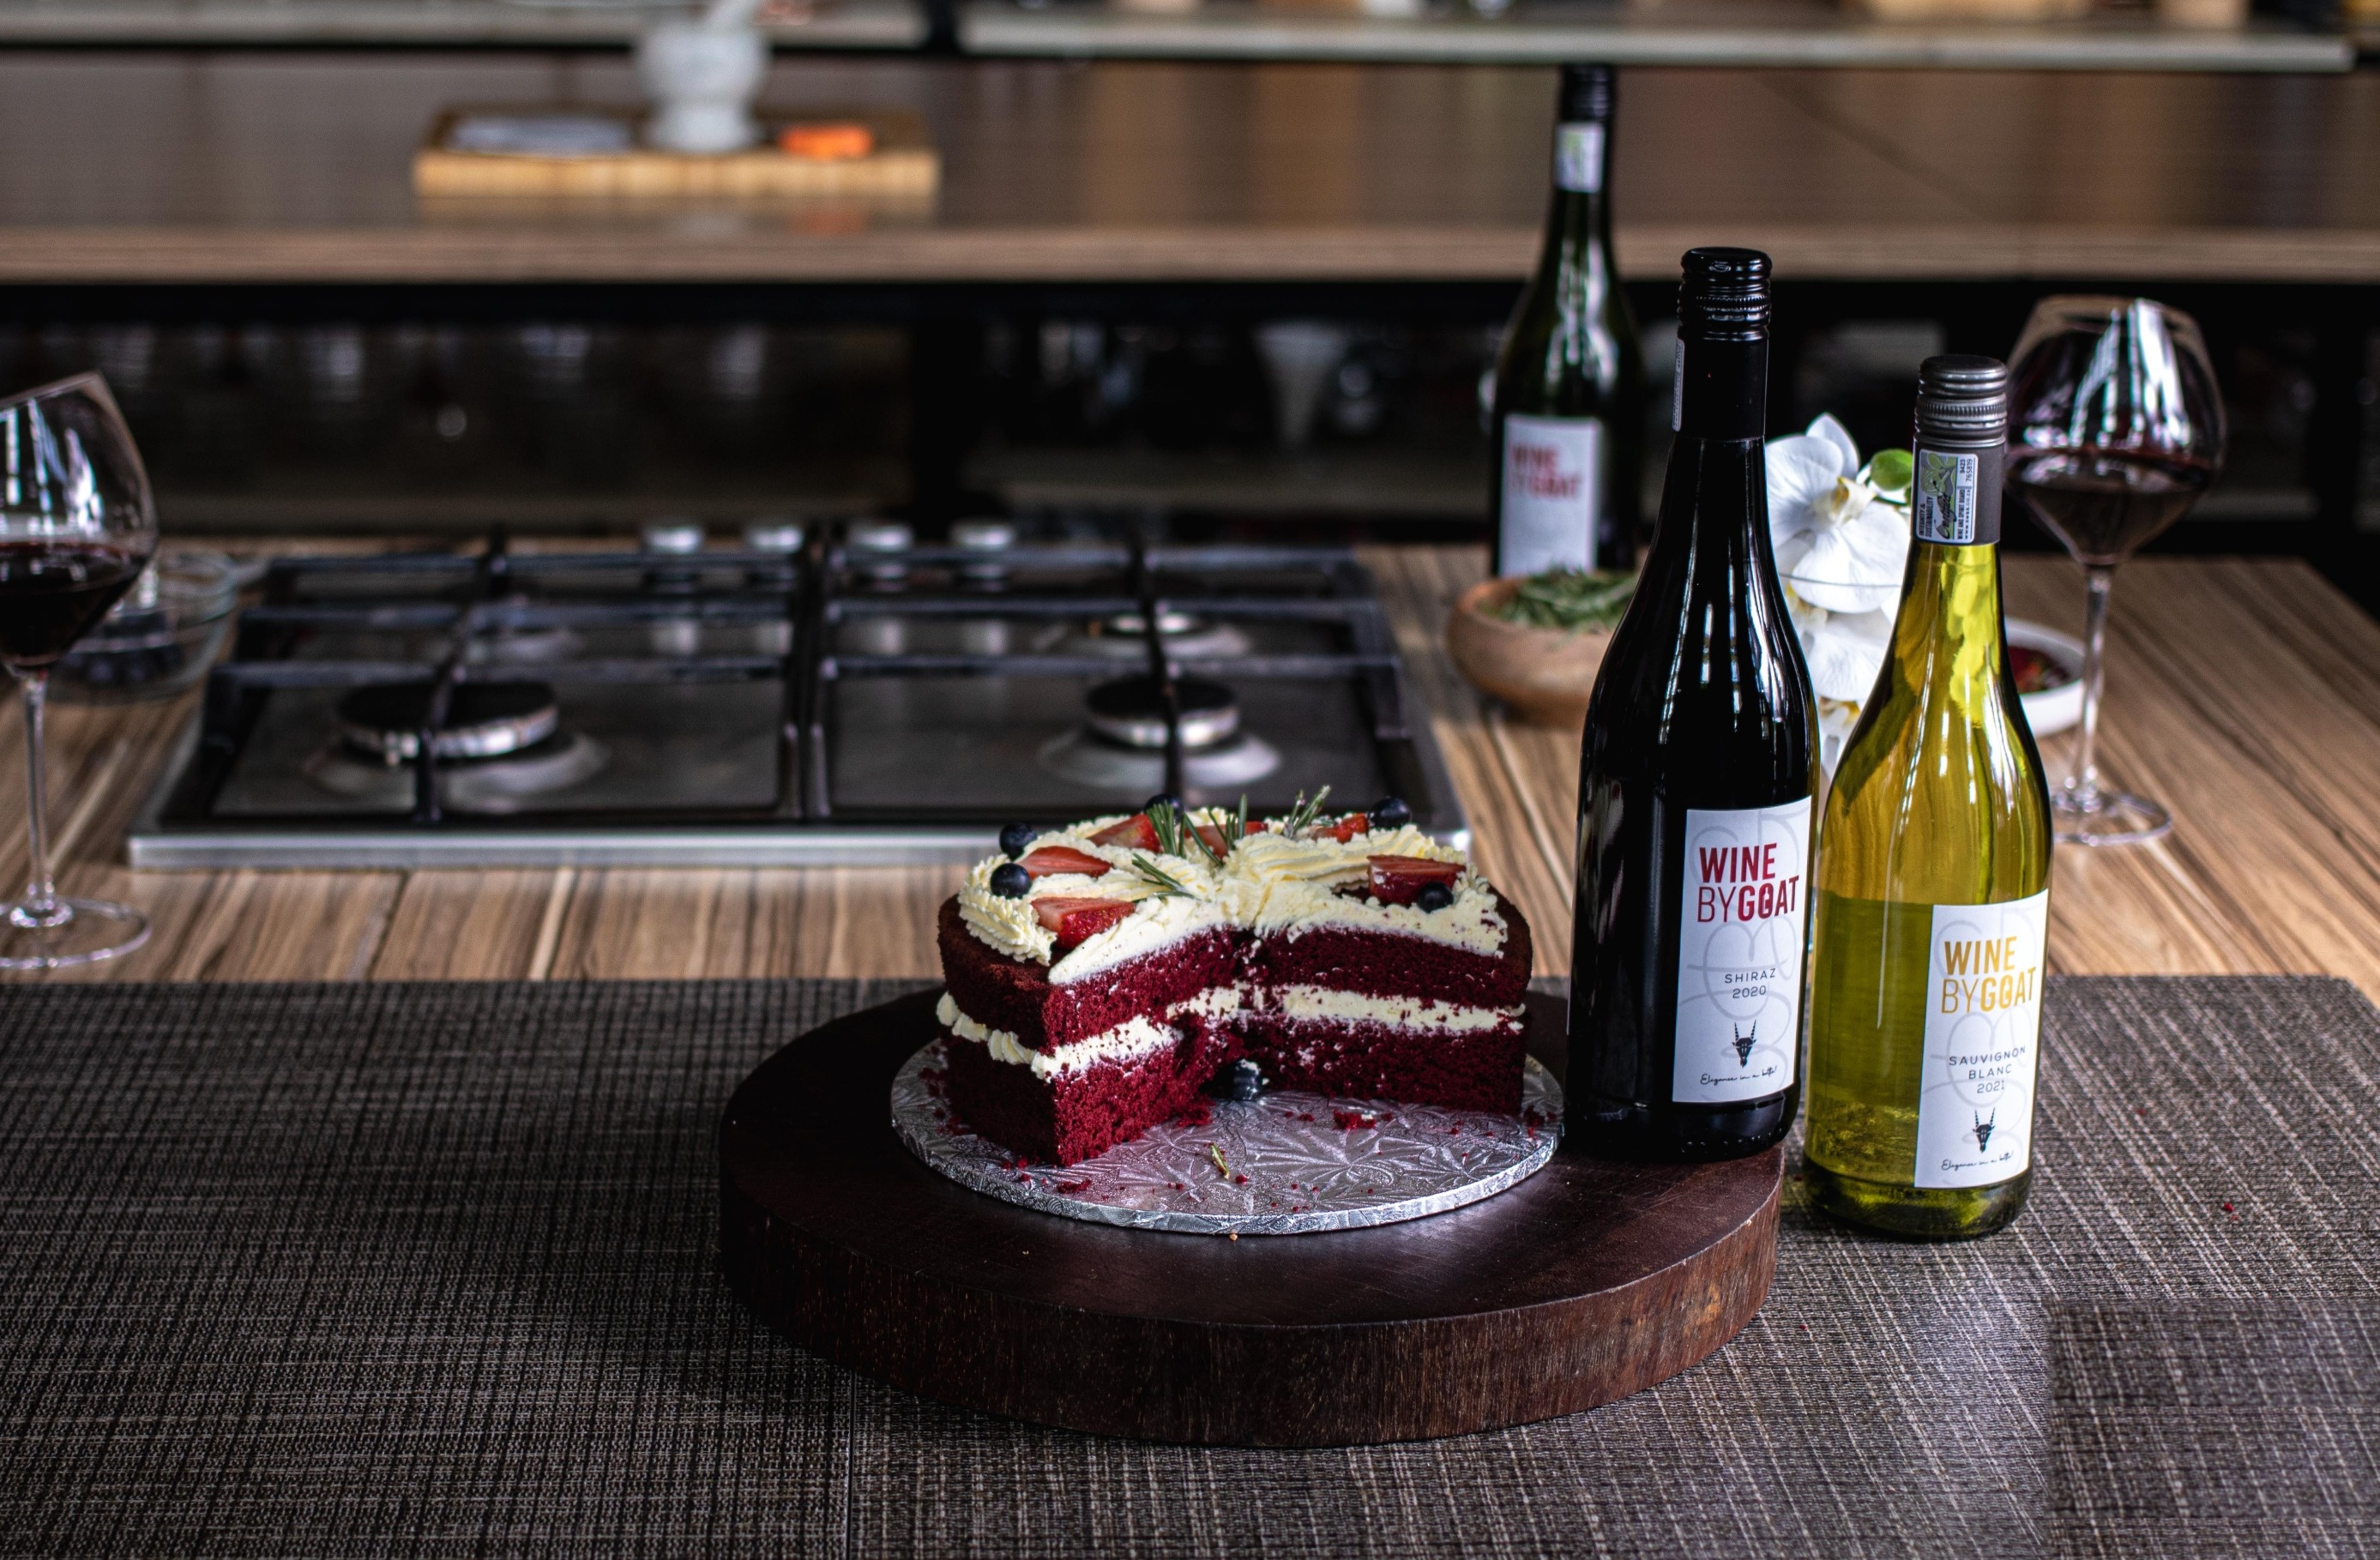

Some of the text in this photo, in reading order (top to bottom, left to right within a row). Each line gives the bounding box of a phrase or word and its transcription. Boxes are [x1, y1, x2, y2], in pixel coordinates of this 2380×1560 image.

[1699, 843, 1777, 883] WINE
[1943, 936, 2017, 976] WINE
[1724, 967, 1776, 985] SHIRAZ
[1732, 985, 1767, 999] 2020
[1949, 1045, 2027, 1066] SAUVIGNON
[1700, 1073, 1738, 1087] Elegance
[1968, 1063, 2013, 1081] BLANC
[1977, 1080, 2005, 1094] 2021
[1941, 1159, 1978, 1172] Elegance
